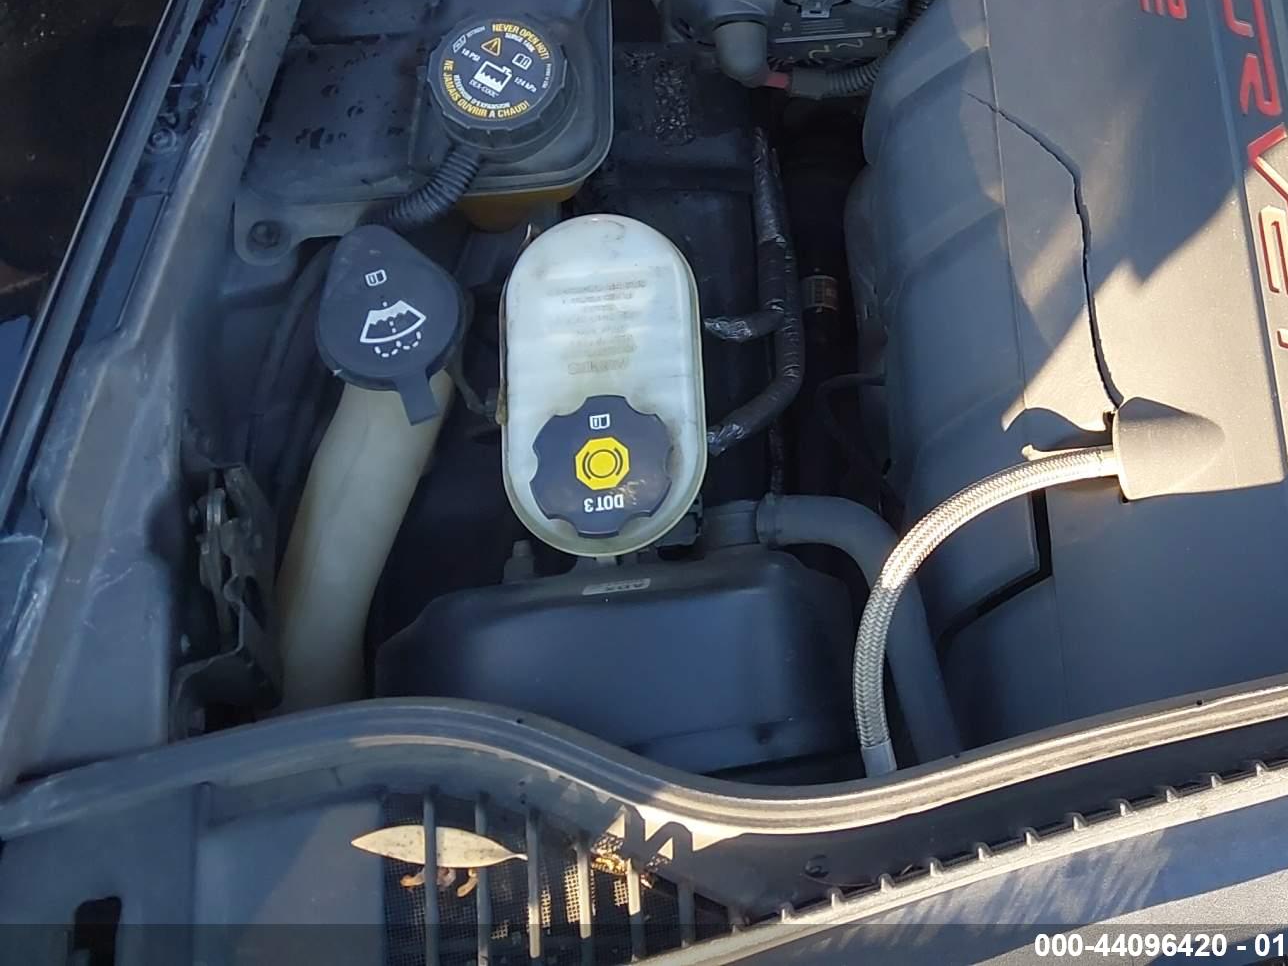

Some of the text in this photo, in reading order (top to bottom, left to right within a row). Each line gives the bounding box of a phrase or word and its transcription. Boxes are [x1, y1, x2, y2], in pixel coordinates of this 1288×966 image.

[492, 23, 519, 34] NEVER
[520, 28, 539, 46] OPEN
[443, 60, 454, 71] NE
[443, 72, 460, 102] JAMAIS
[457, 98, 487, 117] OUVRIR
[497, 100, 531, 118] CHAUD!
[583, 494, 624, 513] DOT 3
